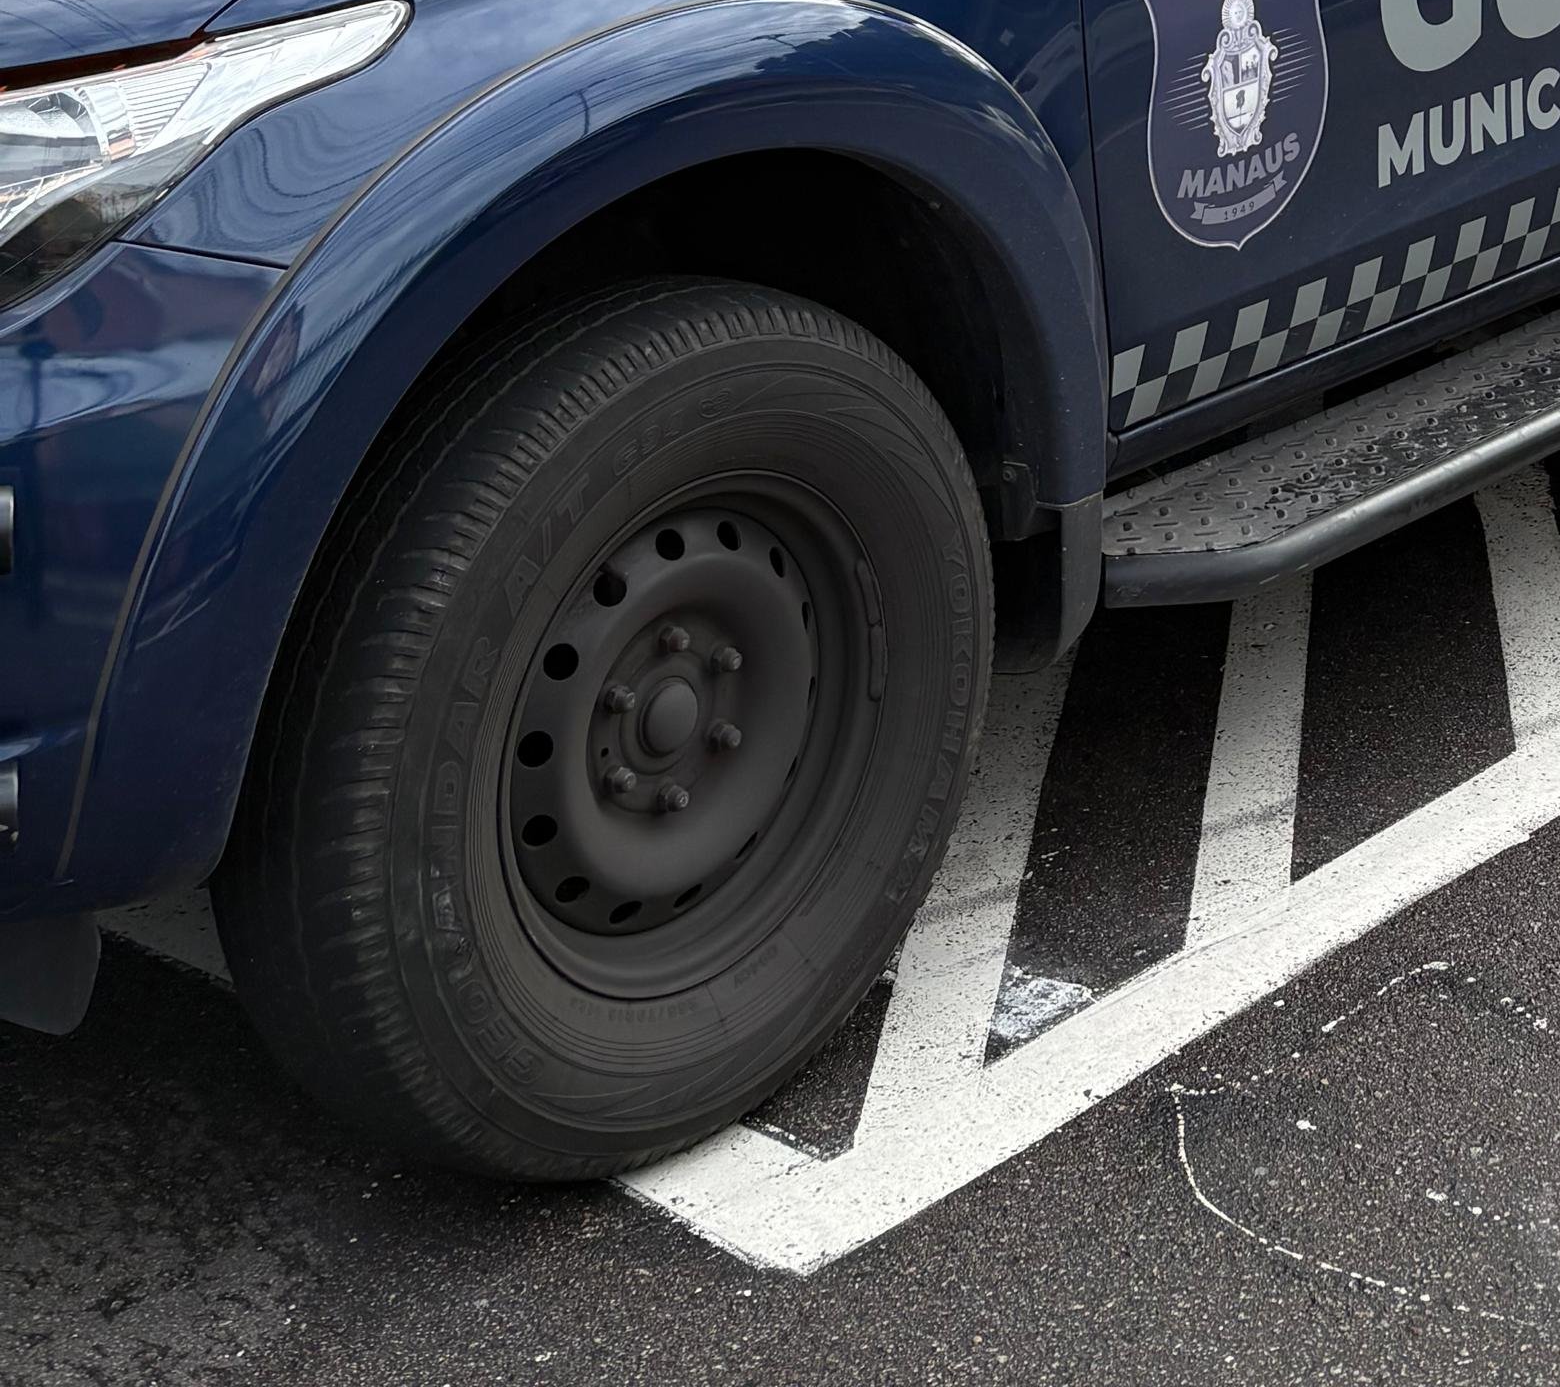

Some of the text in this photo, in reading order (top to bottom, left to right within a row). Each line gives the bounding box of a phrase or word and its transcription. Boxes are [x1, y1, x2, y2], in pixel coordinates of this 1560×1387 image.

[1177, 132, 1301, 200] MANAUS
[1223, 200, 1256, 222] 1949
[885, 526, 974, 908] YOKOHAMA
